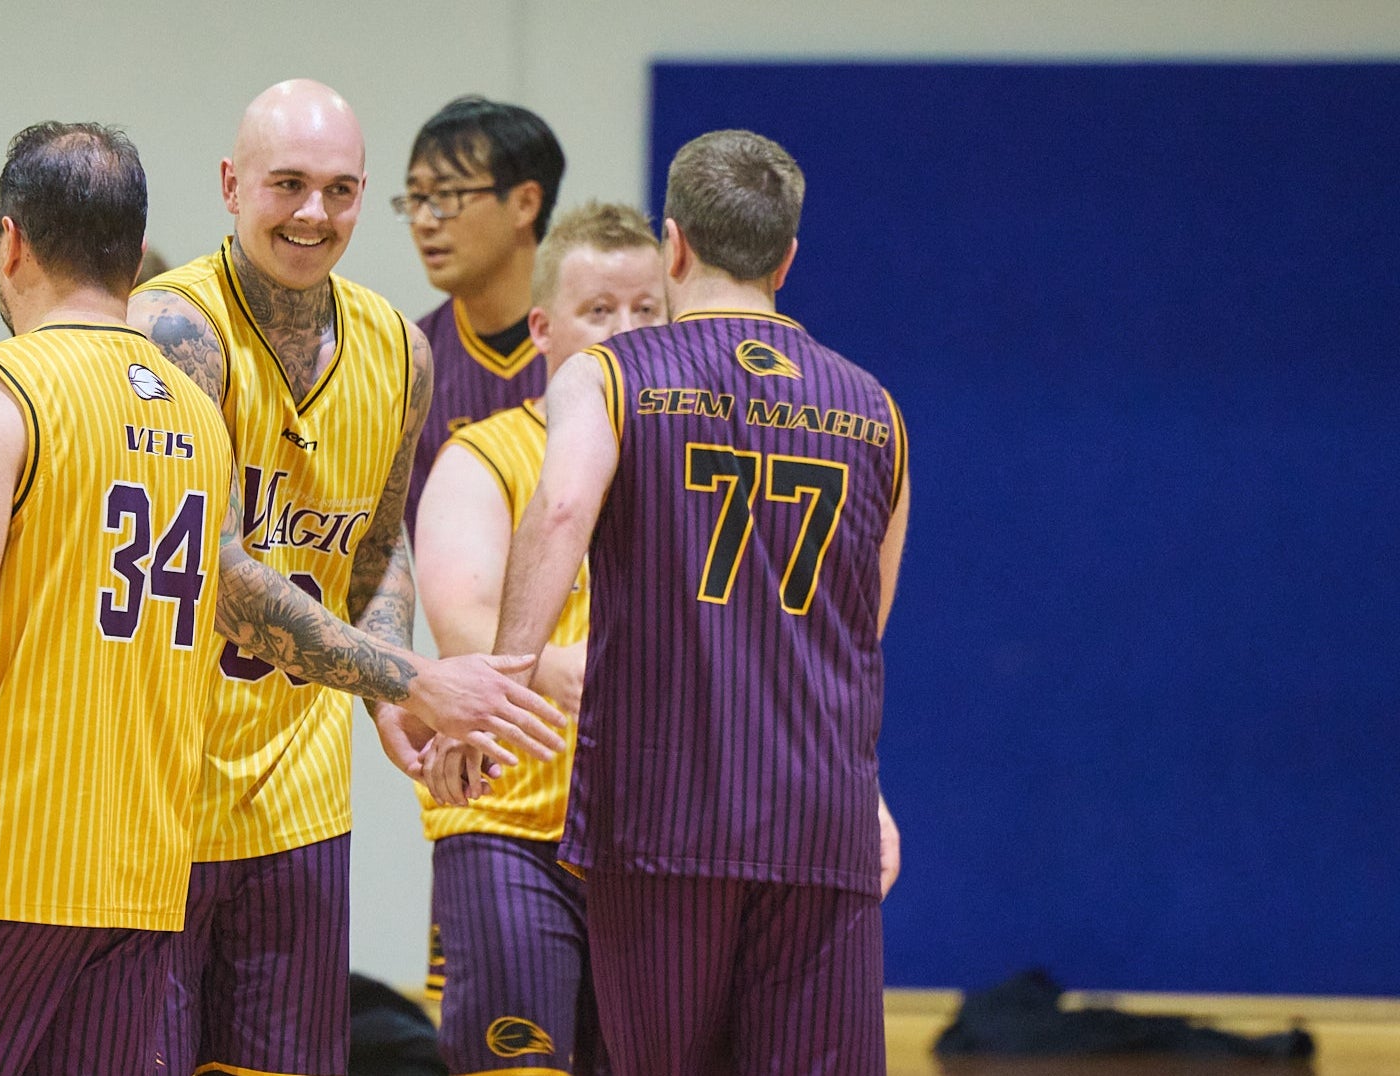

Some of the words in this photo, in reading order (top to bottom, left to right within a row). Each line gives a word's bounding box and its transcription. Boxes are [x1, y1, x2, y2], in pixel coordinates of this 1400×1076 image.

[124, 424, 194, 459] VEIS
[637, 388, 735, 421] SEM
[745, 398, 890, 448] MAGIC
[97, 480, 207, 651] 34
[685, 442, 849, 616] 77
